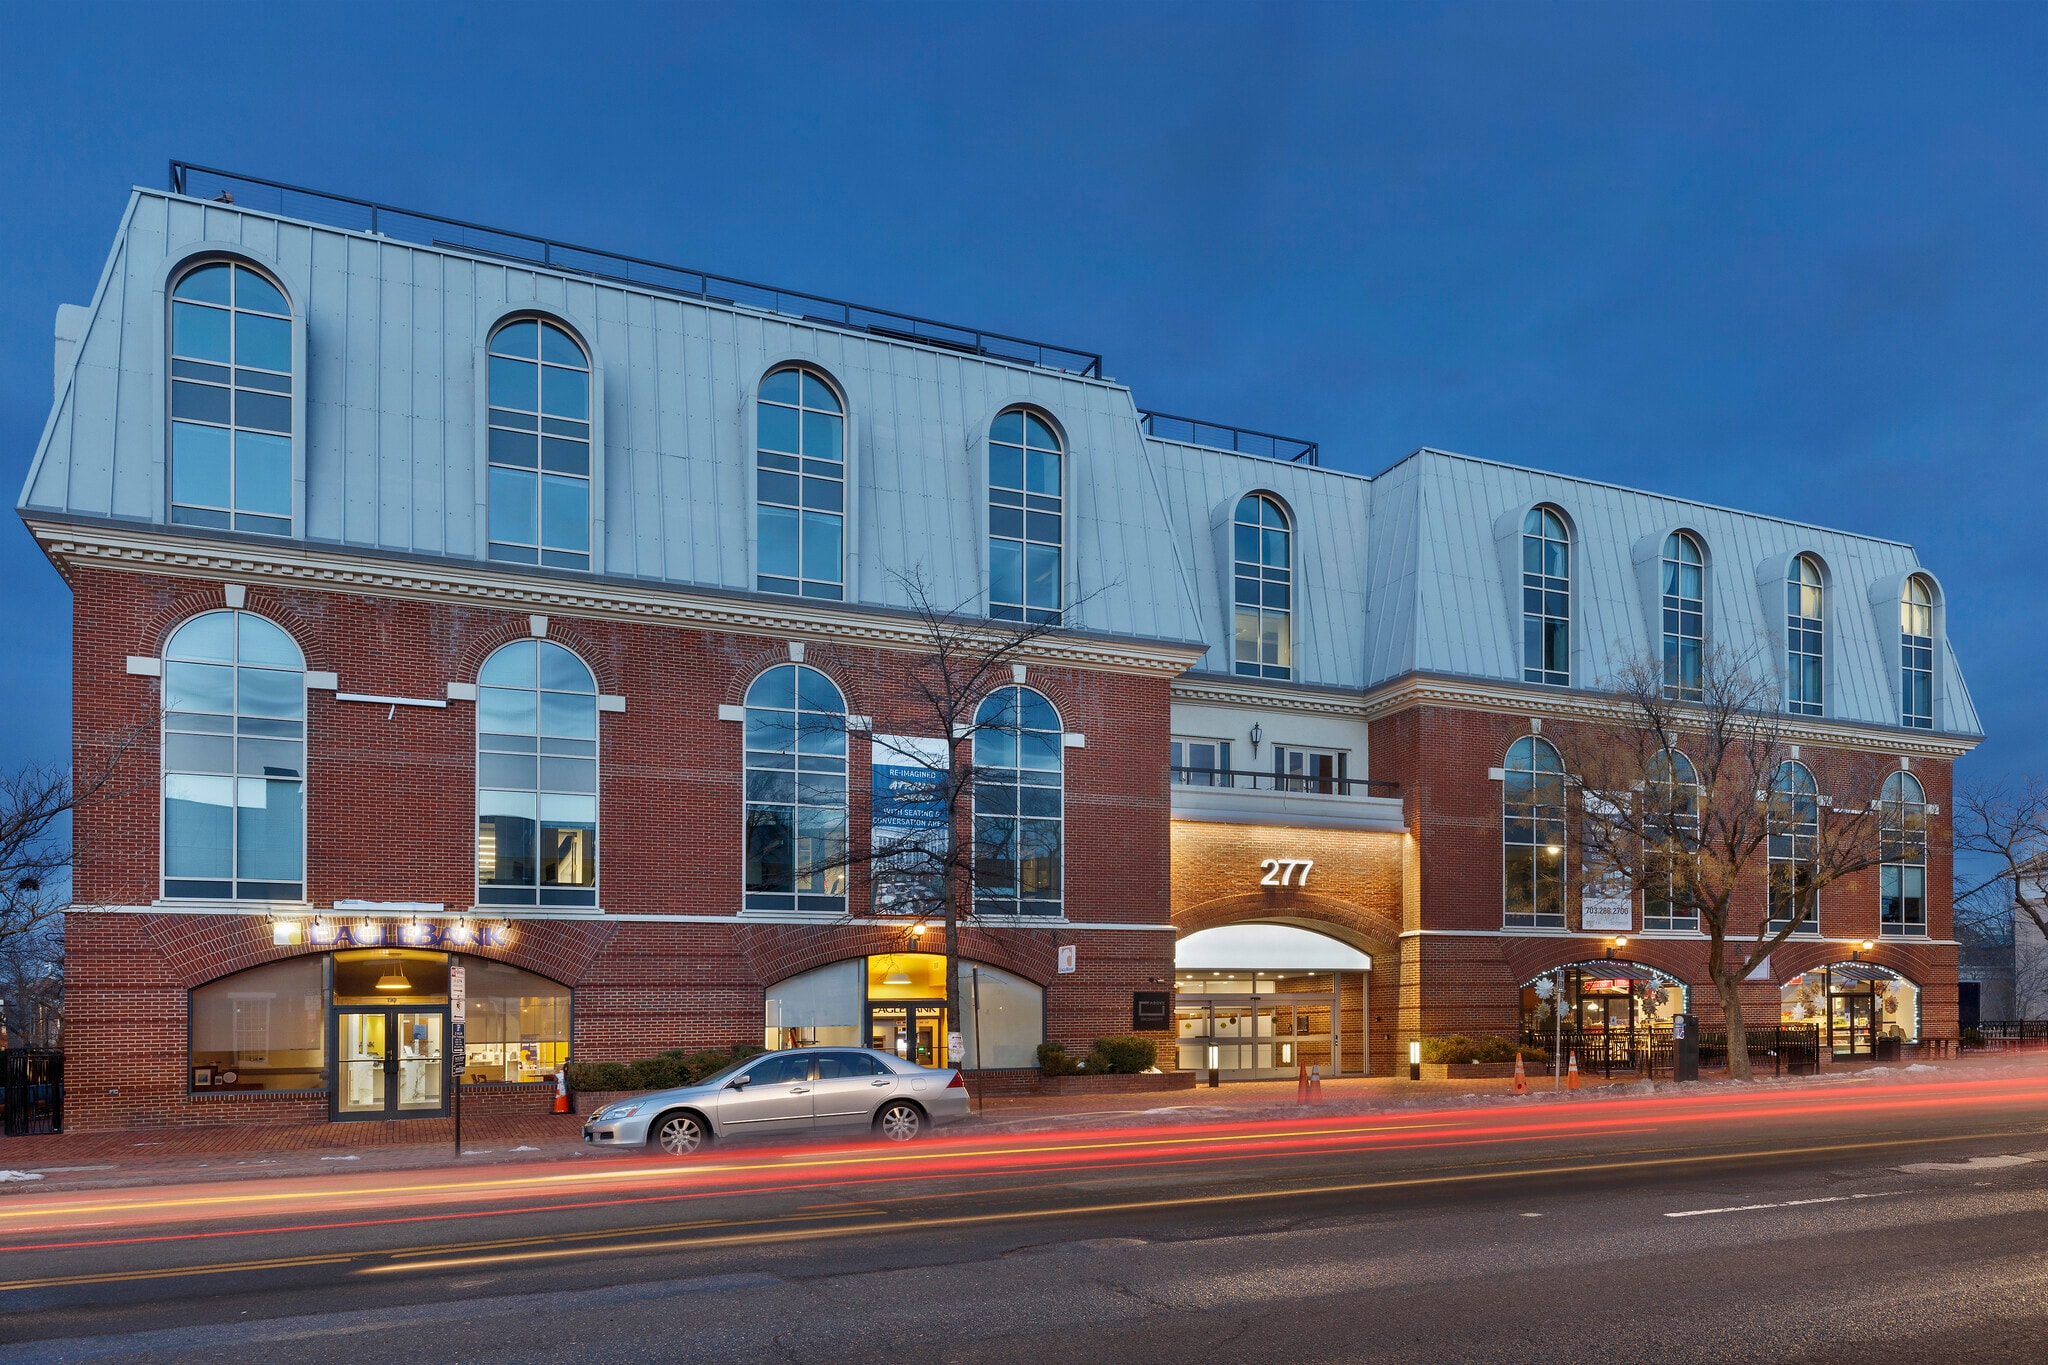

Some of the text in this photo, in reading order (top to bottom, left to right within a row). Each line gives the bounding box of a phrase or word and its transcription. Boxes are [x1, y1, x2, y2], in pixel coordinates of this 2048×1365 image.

[889, 768, 936, 779] RE-IMAGINED
[883, 808, 903, 816] WITH
[904, 809, 934, 818] SEATING
[1260, 858, 1314, 887] 277
[309, 922, 506, 947] EAGLEBANK
